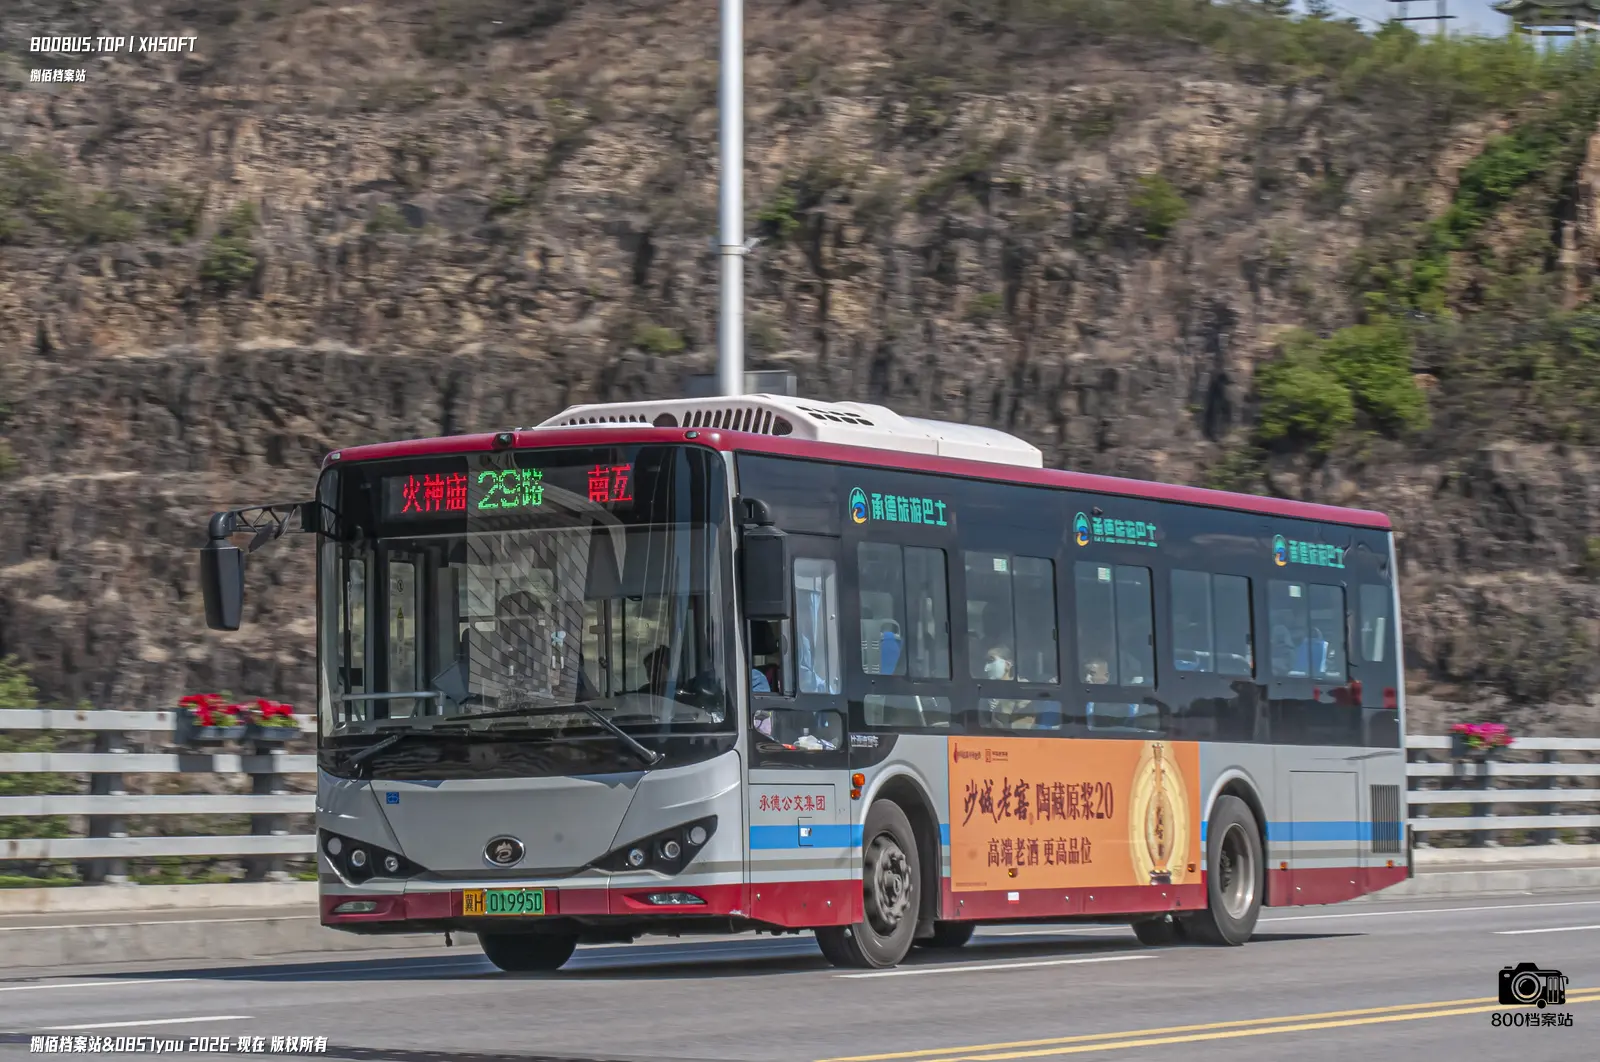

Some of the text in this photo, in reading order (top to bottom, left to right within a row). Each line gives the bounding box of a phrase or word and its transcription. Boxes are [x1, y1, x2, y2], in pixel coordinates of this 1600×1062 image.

[401, 472, 467, 513] 火神庙
[477, 468, 543, 510] 29路
[871, 493, 948, 527] 承德旅游巴士
[987, 836, 1093, 868] 高端老酒 更高品位
[465, 893, 484, 912] 冀H
